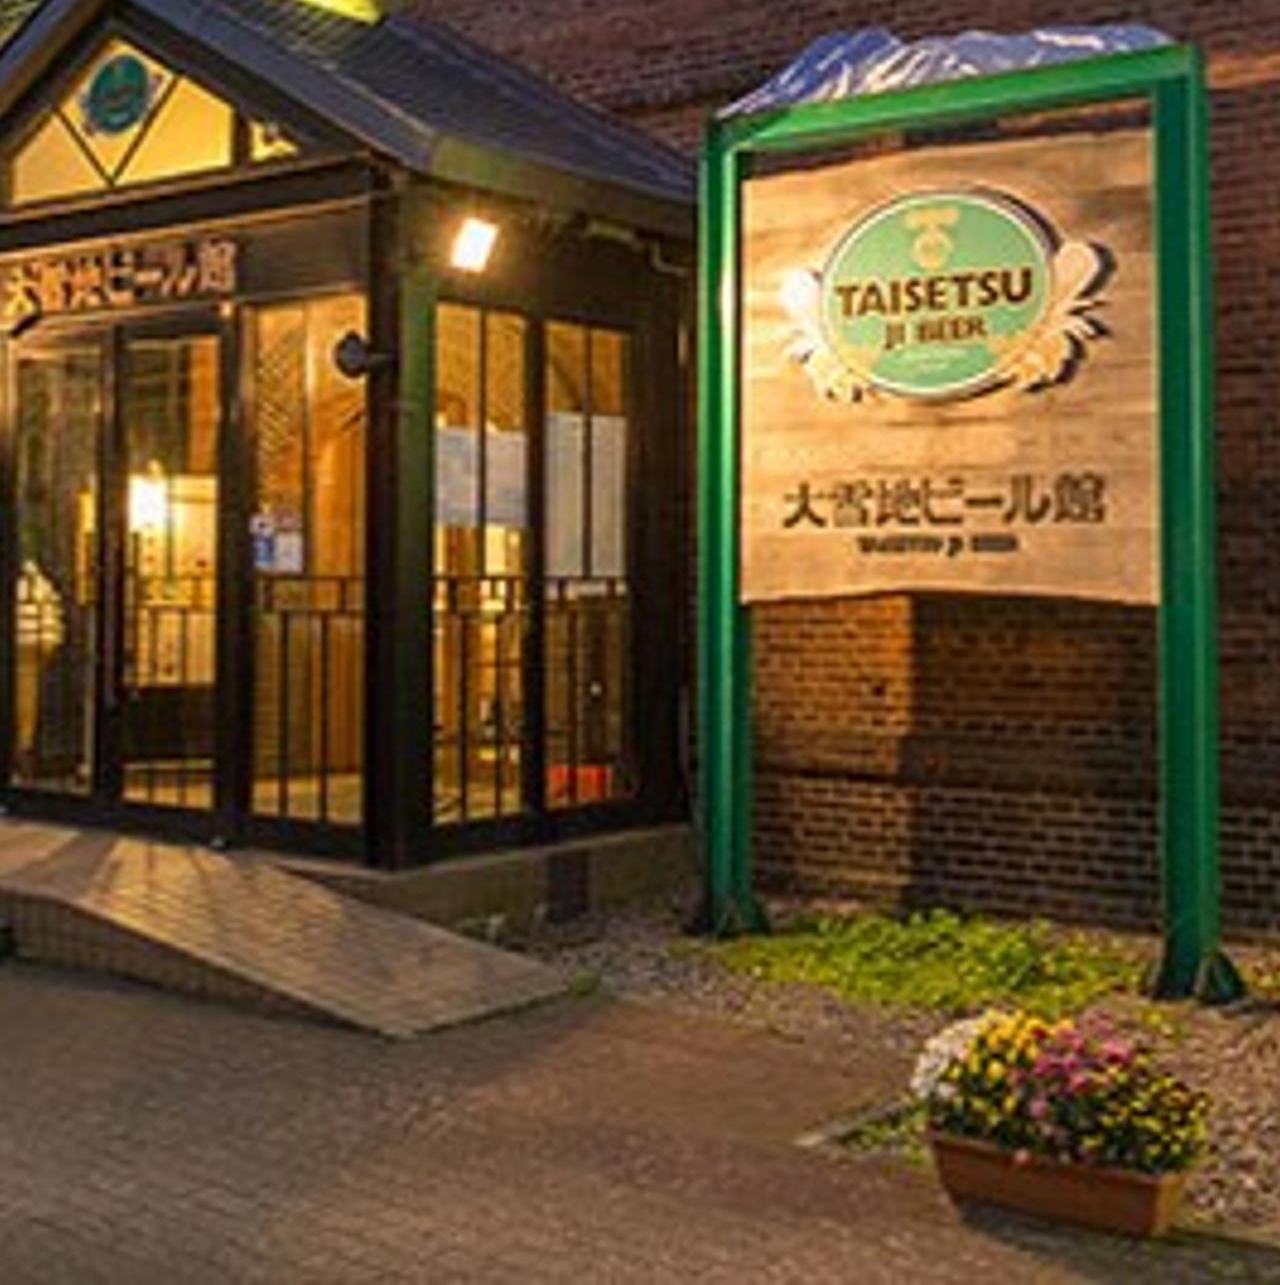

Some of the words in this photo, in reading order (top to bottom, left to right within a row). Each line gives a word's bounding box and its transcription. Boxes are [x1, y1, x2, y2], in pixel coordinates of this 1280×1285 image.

[834, 267, 1033, 318] TAISETSU
[917, 316, 988, 343] BEER
[783, 470, 1108, 528] 大雪地ビール館
